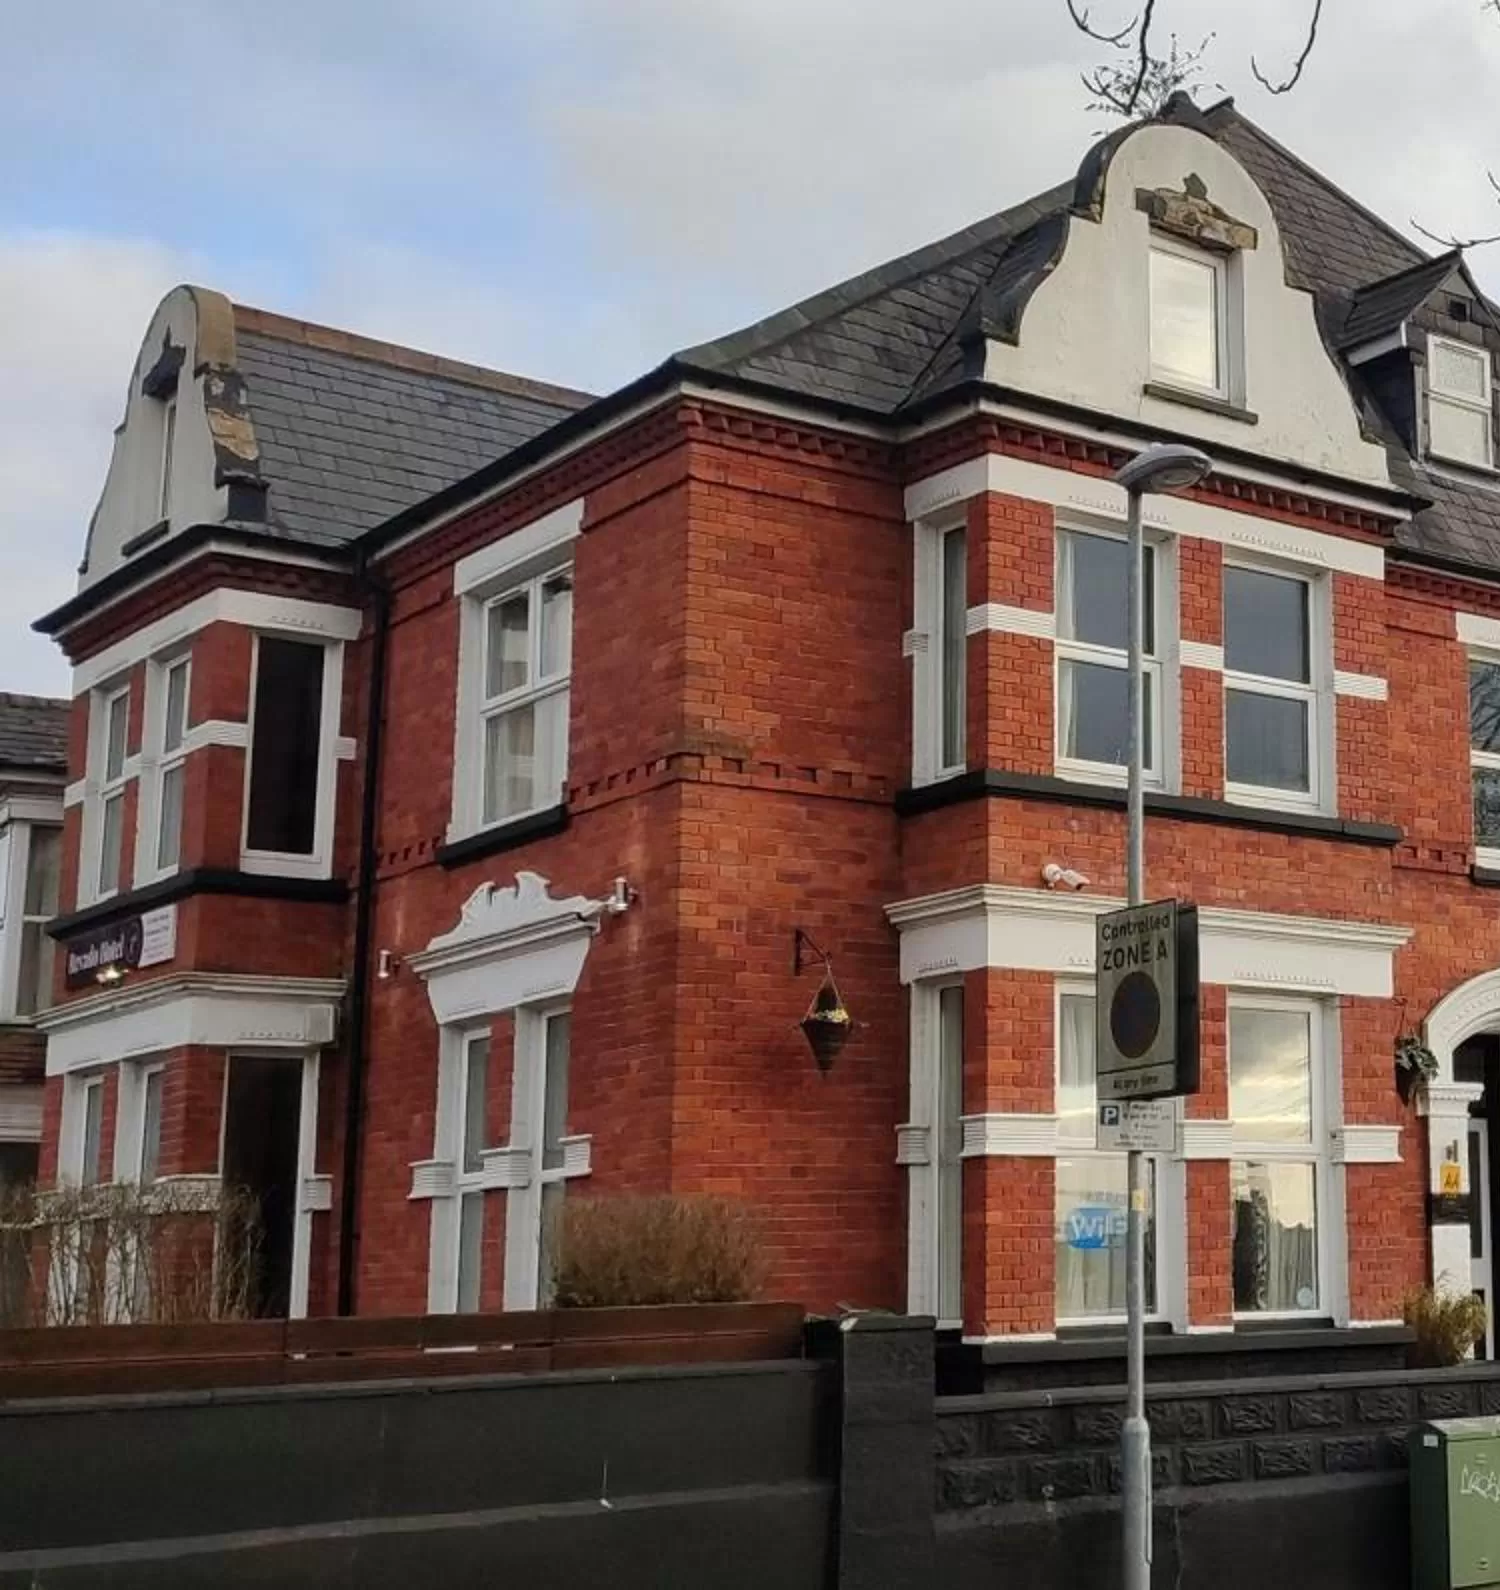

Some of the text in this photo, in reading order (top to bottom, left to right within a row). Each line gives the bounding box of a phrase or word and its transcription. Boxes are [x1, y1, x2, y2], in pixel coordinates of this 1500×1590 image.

[1101, 913, 1171, 941] Controlled
[1103, 940, 1169, 970] ZONE A
[1103, 1107, 1118, 1125] P
